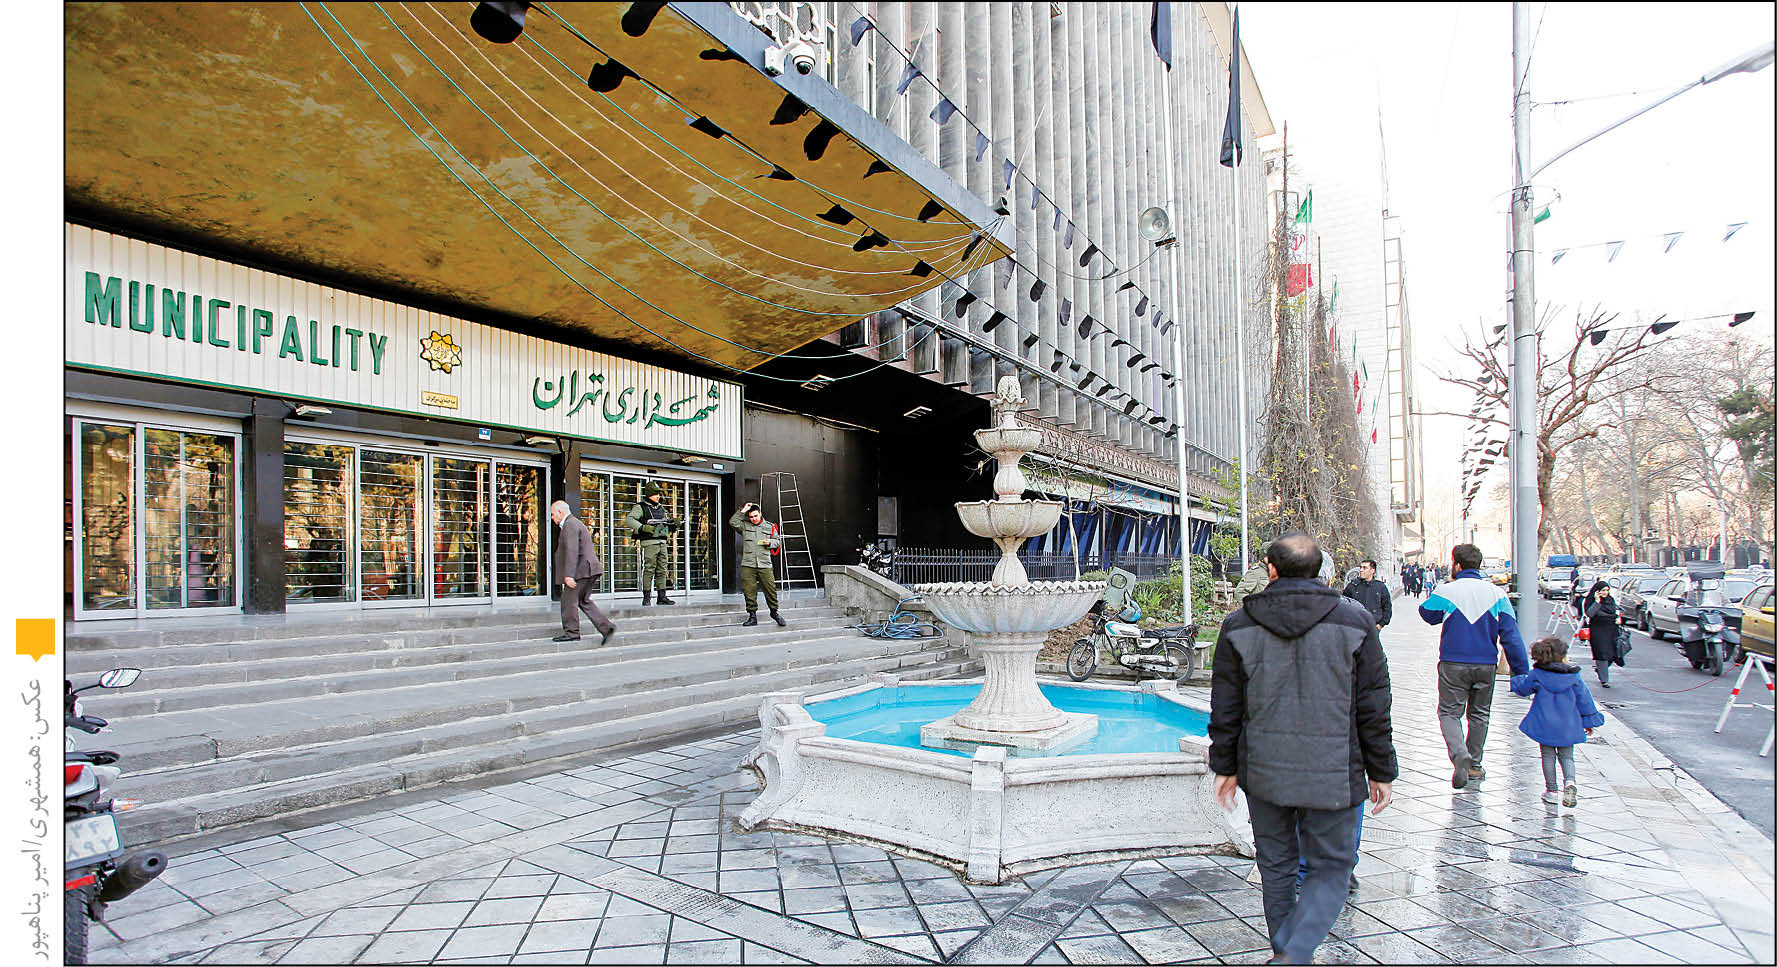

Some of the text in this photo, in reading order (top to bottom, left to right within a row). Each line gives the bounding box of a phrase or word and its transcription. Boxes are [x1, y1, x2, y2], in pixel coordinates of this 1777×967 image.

[85, 271, 388, 375] MUNICIPALITY
[533, 369, 720, 429] شهرداری تهران
